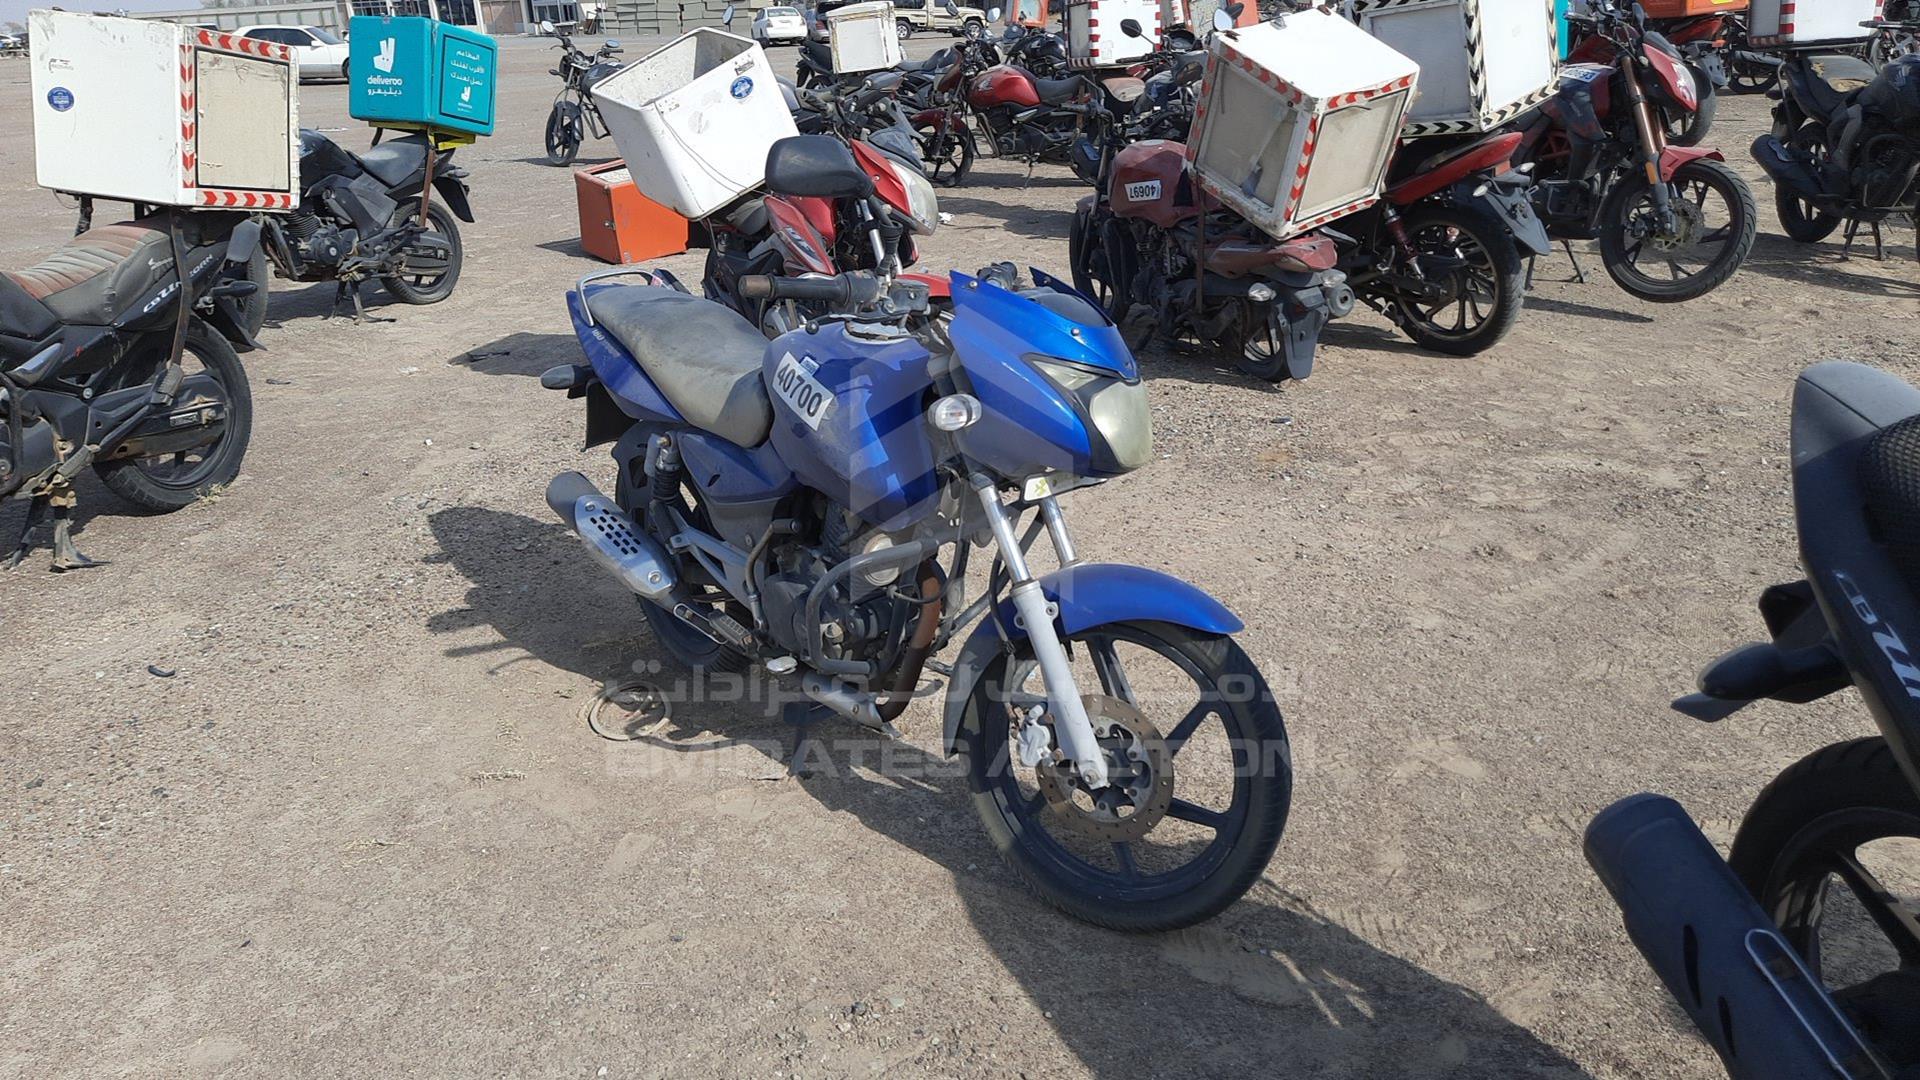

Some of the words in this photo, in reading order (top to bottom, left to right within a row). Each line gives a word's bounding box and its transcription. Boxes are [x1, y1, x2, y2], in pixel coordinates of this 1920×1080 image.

[367, 75, 403, 86] deliveroo
[1129, 184, 1156, 199] 40697
[777, 362, 823, 418] 40700
